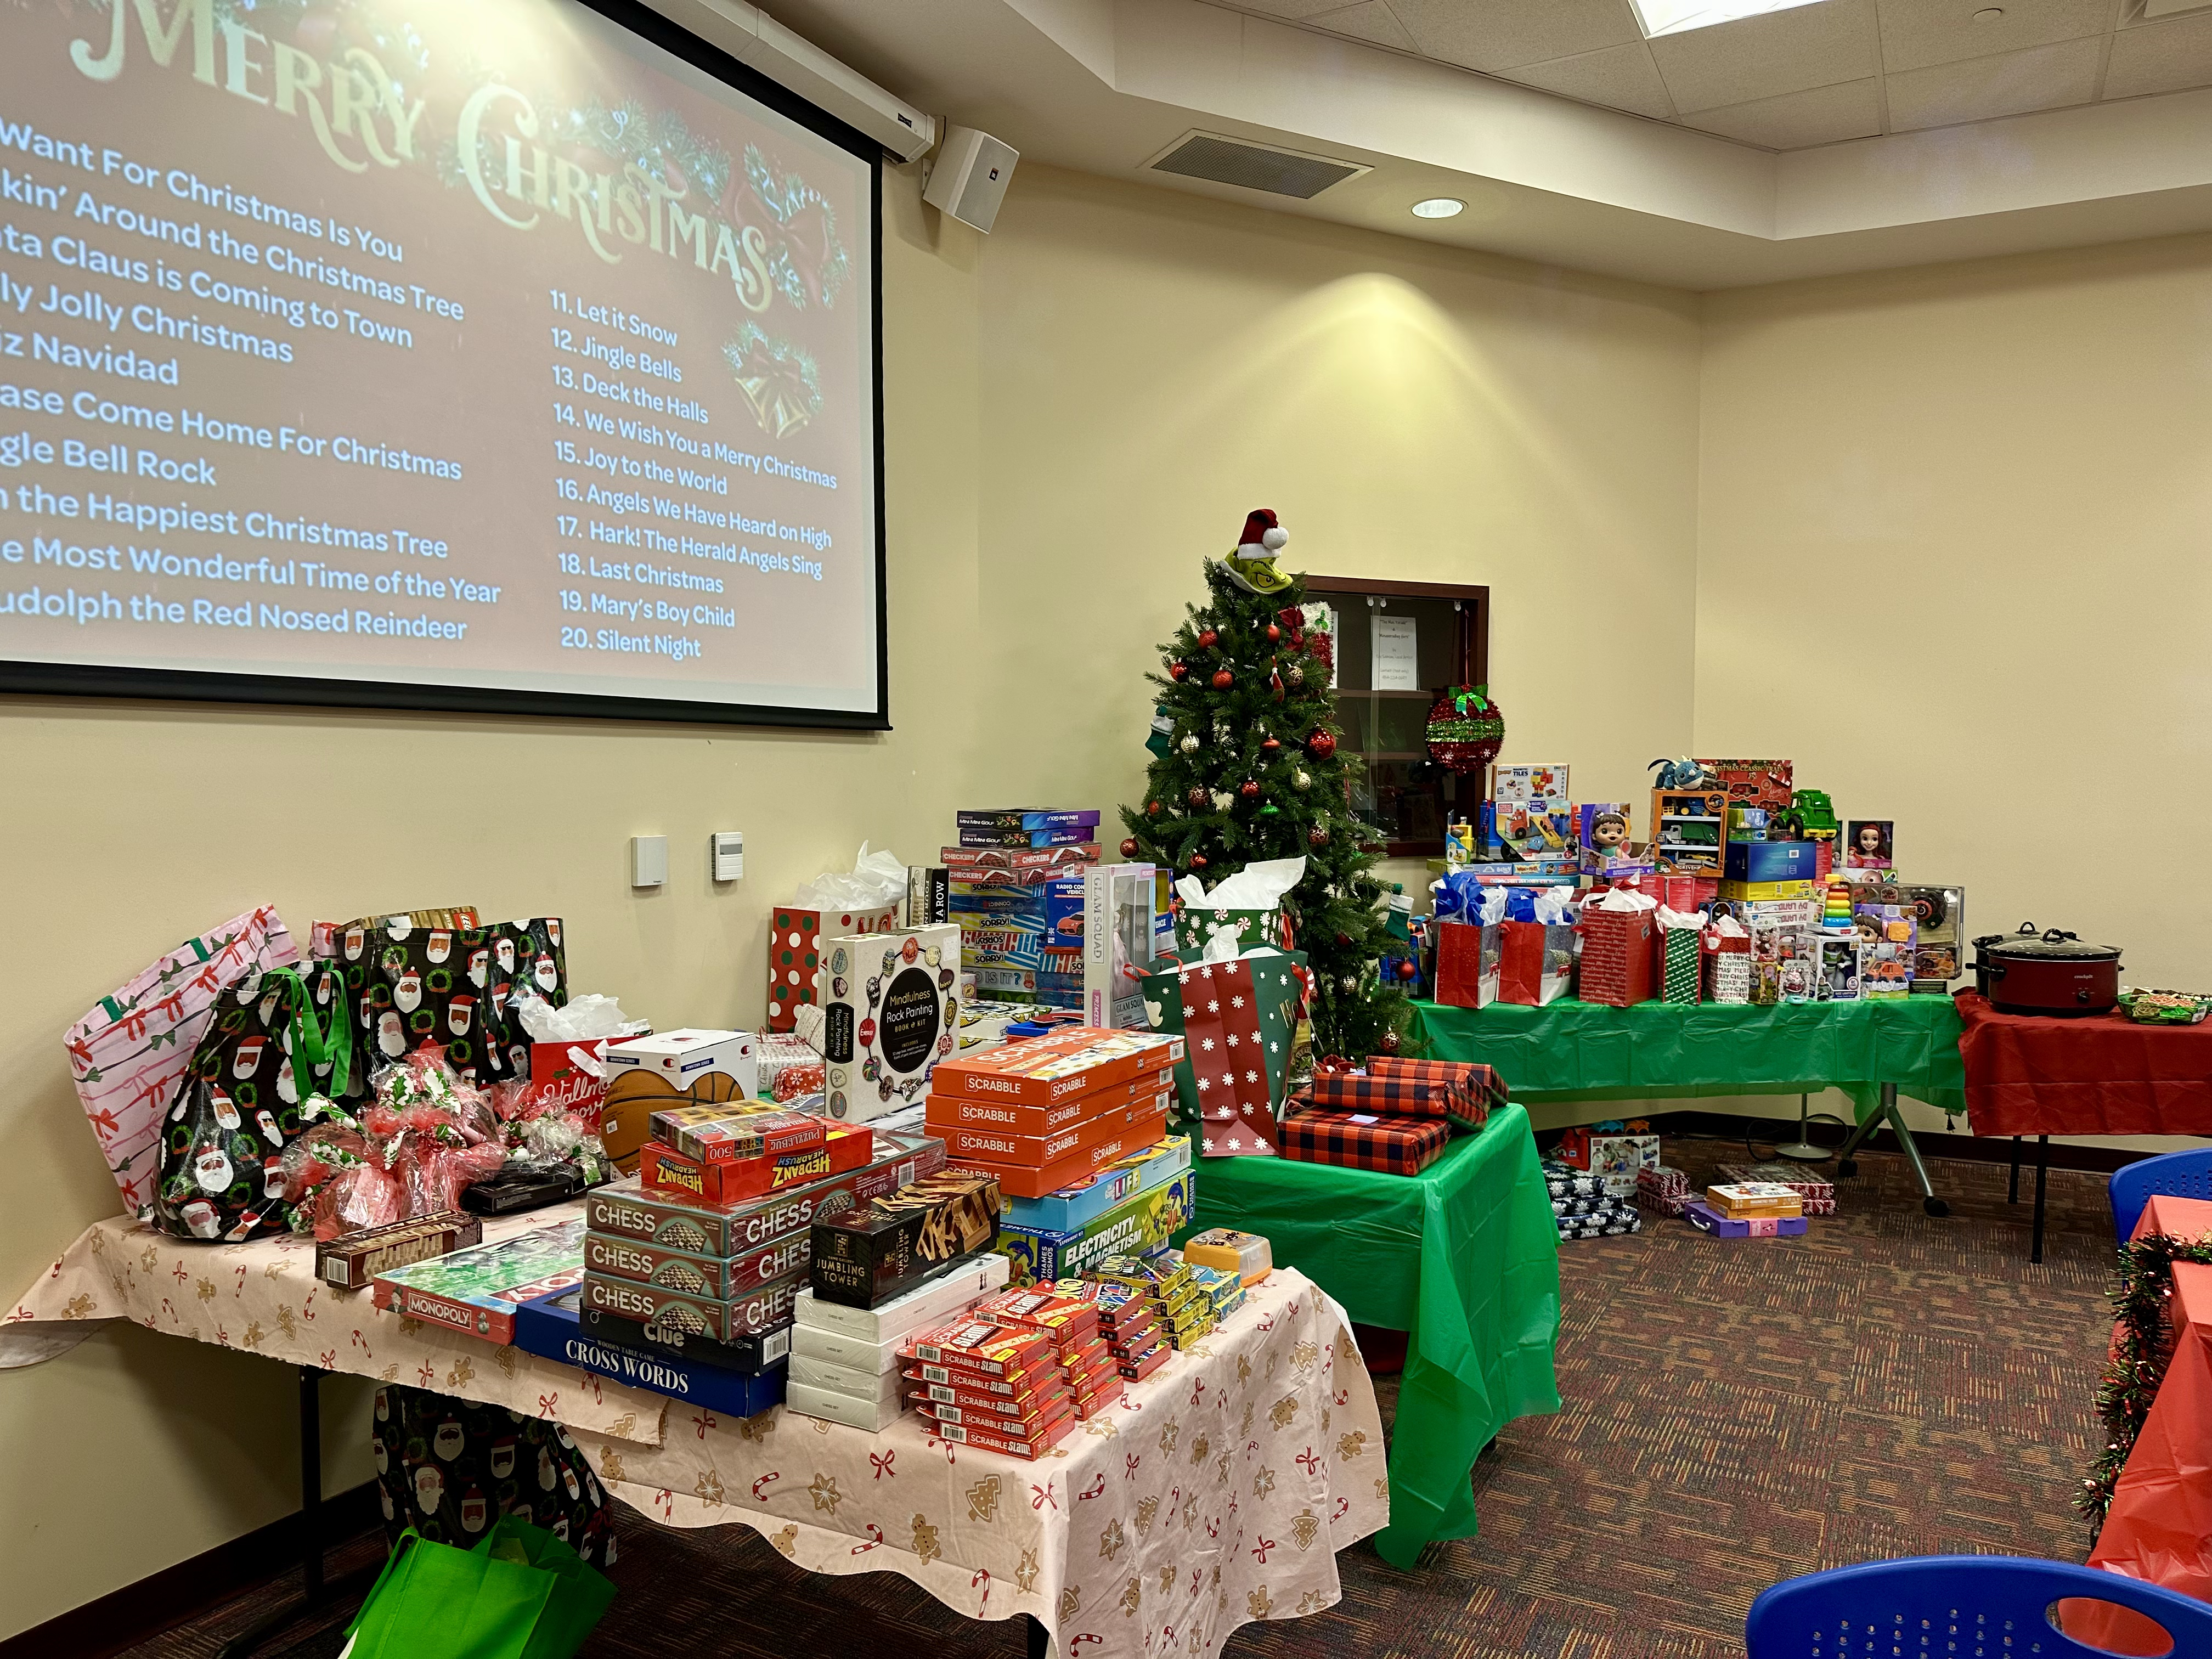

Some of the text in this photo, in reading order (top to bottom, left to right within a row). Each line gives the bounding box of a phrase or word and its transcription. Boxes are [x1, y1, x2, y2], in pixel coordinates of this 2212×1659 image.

[0, 117, 402, 262] Want For Christmas Is You
[75, 192, 201, 249] Around
[207, 230, 259, 264] the
[265, 245, 405, 304] Christmas
[409, 285, 464, 320] Tree
[51, 235, 149, 283] Claus
[156, 259, 182, 291] is
[189, 270, 306, 328] Coming
[309, 302, 338, 329] to
[343, 309, 412, 347] Town
[41, 285, 123, 331] Jolly
[131, 304, 293, 363] Christmas
[549, 289, 677, 346] 11. Let it Snow
[33, 332, 178, 385] Navidad
[551, 327, 681, 382] 12. Jingle Bells
[552, 364, 708, 424] 13. Deck the Halls
[72, 391, 174, 432] Come
[181, 409, 272, 448] Home
[279, 426, 327, 455] For
[331, 436, 461, 480] Christmas
[553, 402, 837, 489] 14. We Wish You a Merry Christmas
[63, 439, 128, 472] Bell
[137, 449, 215, 485] Rock
[554, 439, 727, 494] 15. Joy to the World
[17, 484, 447, 558] the Happiest Christmas Tree
[555, 477, 832, 550] 16. Angels We Have Heard on High
[556, 515, 822, 580] 17. Hark! The Herald Angels Sing
[32, 537, 121, 570] Most
[128, 546, 295, 584] Wonderful
[300, 562, 369, 591] Time
[374, 570, 401, 593] of
[403, 573, 446, 599] the
[449, 577, 500, 602] Year
[558, 552, 724, 593] 18. Last Christmas
[129, 594, 185, 623] the
[192, 599, 252, 626] Red
[259, 603, 348, 632] Nosed
[354, 610, 467, 639] Reindeer
[559, 590, 735, 627] 19. Mary's Boy Child
[561, 625, 701, 661] 20. Silent Night
[1022, 854, 1049, 864] CHECKERS
[936, 882, 944, 907] ROW
[980, 918, 1010, 928] SORRY!
[1093, 877, 1102, 958] GLAM SQUAD
[887, 1005, 933, 1024] Rock Painting
[890, 990, 930, 1007] Mindfulness
[895, 1023, 909, 1033] BOOK
[977, 1030, 1097, 1064] SCRABBLE
[968, 1077, 1021, 1094] SCRABBLE
[1053, 1076, 1086, 1096] SCRABBLE
[962, 1106, 1016, 1122] SCRABBLE
[1048, 1104, 1081, 1125] SCRABBLE
[709, 1146, 732, 1160] 500
[656, 1163, 704, 1196] HEDBANZ
[1115, 1170, 1139, 1201] LIFE
[595, 1204, 656, 1232] CHESS
[747, 1199, 812, 1243] CHESS
[592, 1245, 653, 1274] CHESS
[1065, 1215, 1137, 1268] ELECTRICITY
[1085, 1228, 1142, 1270] MAGNETISM
[817, 1259, 865, 1277] JUMBLING
[824, 1272, 857, 1287] TOWER
[411, 1297, 469, 1325] MONOPOLY
[597, 1340, 655, 1362] WOODEN TABLE GAME
[643, 1322, 684, 1347] Clue
[566, 1339, 689, 1394] CROSS WORDS
[945, 1355, 980, 1369] SCRABBLE
[952, 1375, 989, 1390] SCRABBLE
